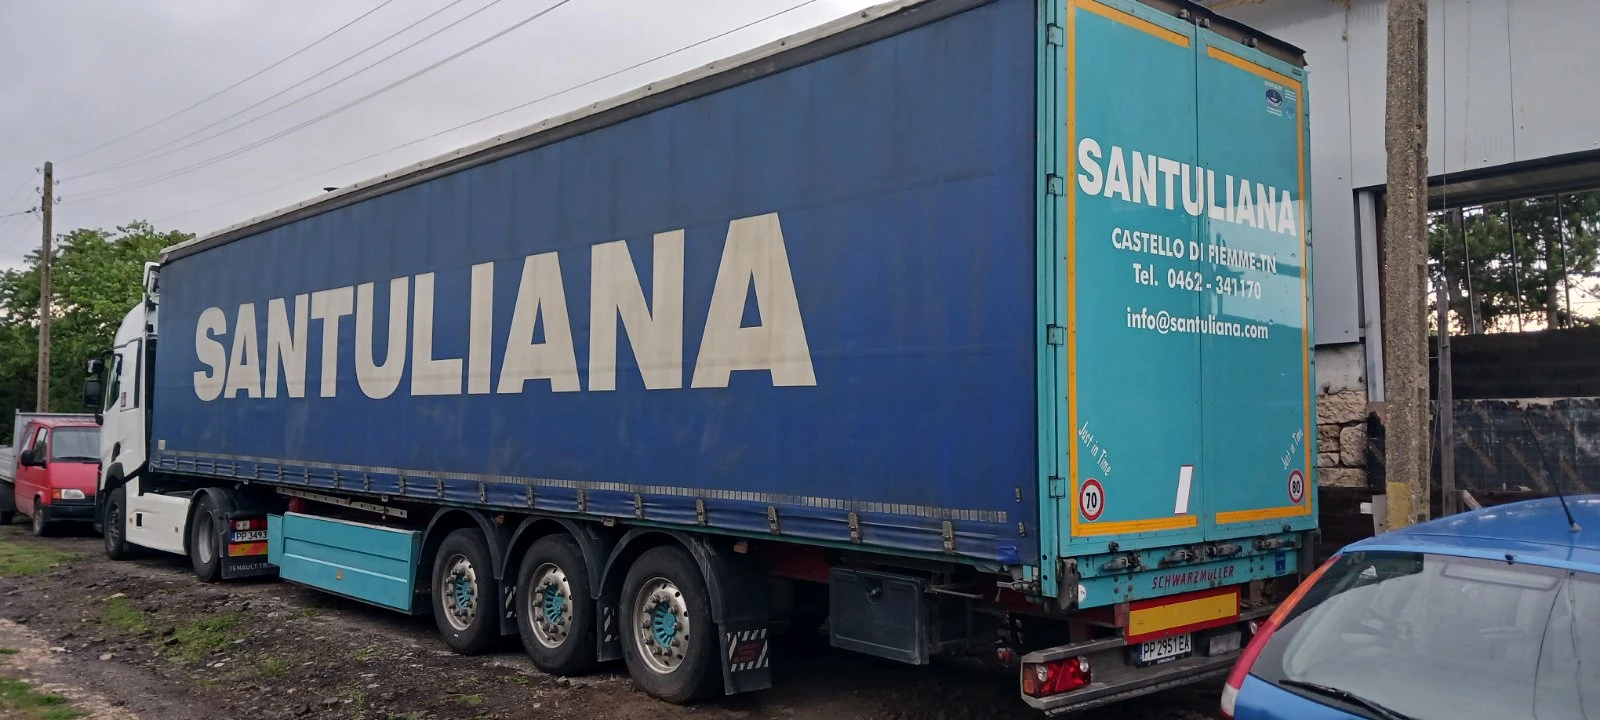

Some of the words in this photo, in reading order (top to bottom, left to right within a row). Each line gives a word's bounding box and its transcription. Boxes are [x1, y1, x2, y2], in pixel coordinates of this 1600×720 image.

[1077, 138, 1297, 236] SANTULIANA
[1111, 227, 1184, 259] CASTELLO
[1189, 241, 1204, 262] DI
[1208, 244, 1277, 275] FIEMME-TN
[1133, 263, 1159, 287] Tel.
[1167, 268, 1203, 292] 0462
[1216, 275, 1262, 300] 341170
[193, 212, 818, 402] SANTULIANA
[1127, 306, 1269, 340] info@santuliana.com
[1078, 421, 1094, 447] Just
[1090, 440, 1099, 457] in
[1097, 448, 1112, 476] Time
[1085, 492, 1097, 509] 70
[1292, 480, 1301, 494] 80
[236, 532, 247, 540] PP
[248, 531, 267, 540] 3493
